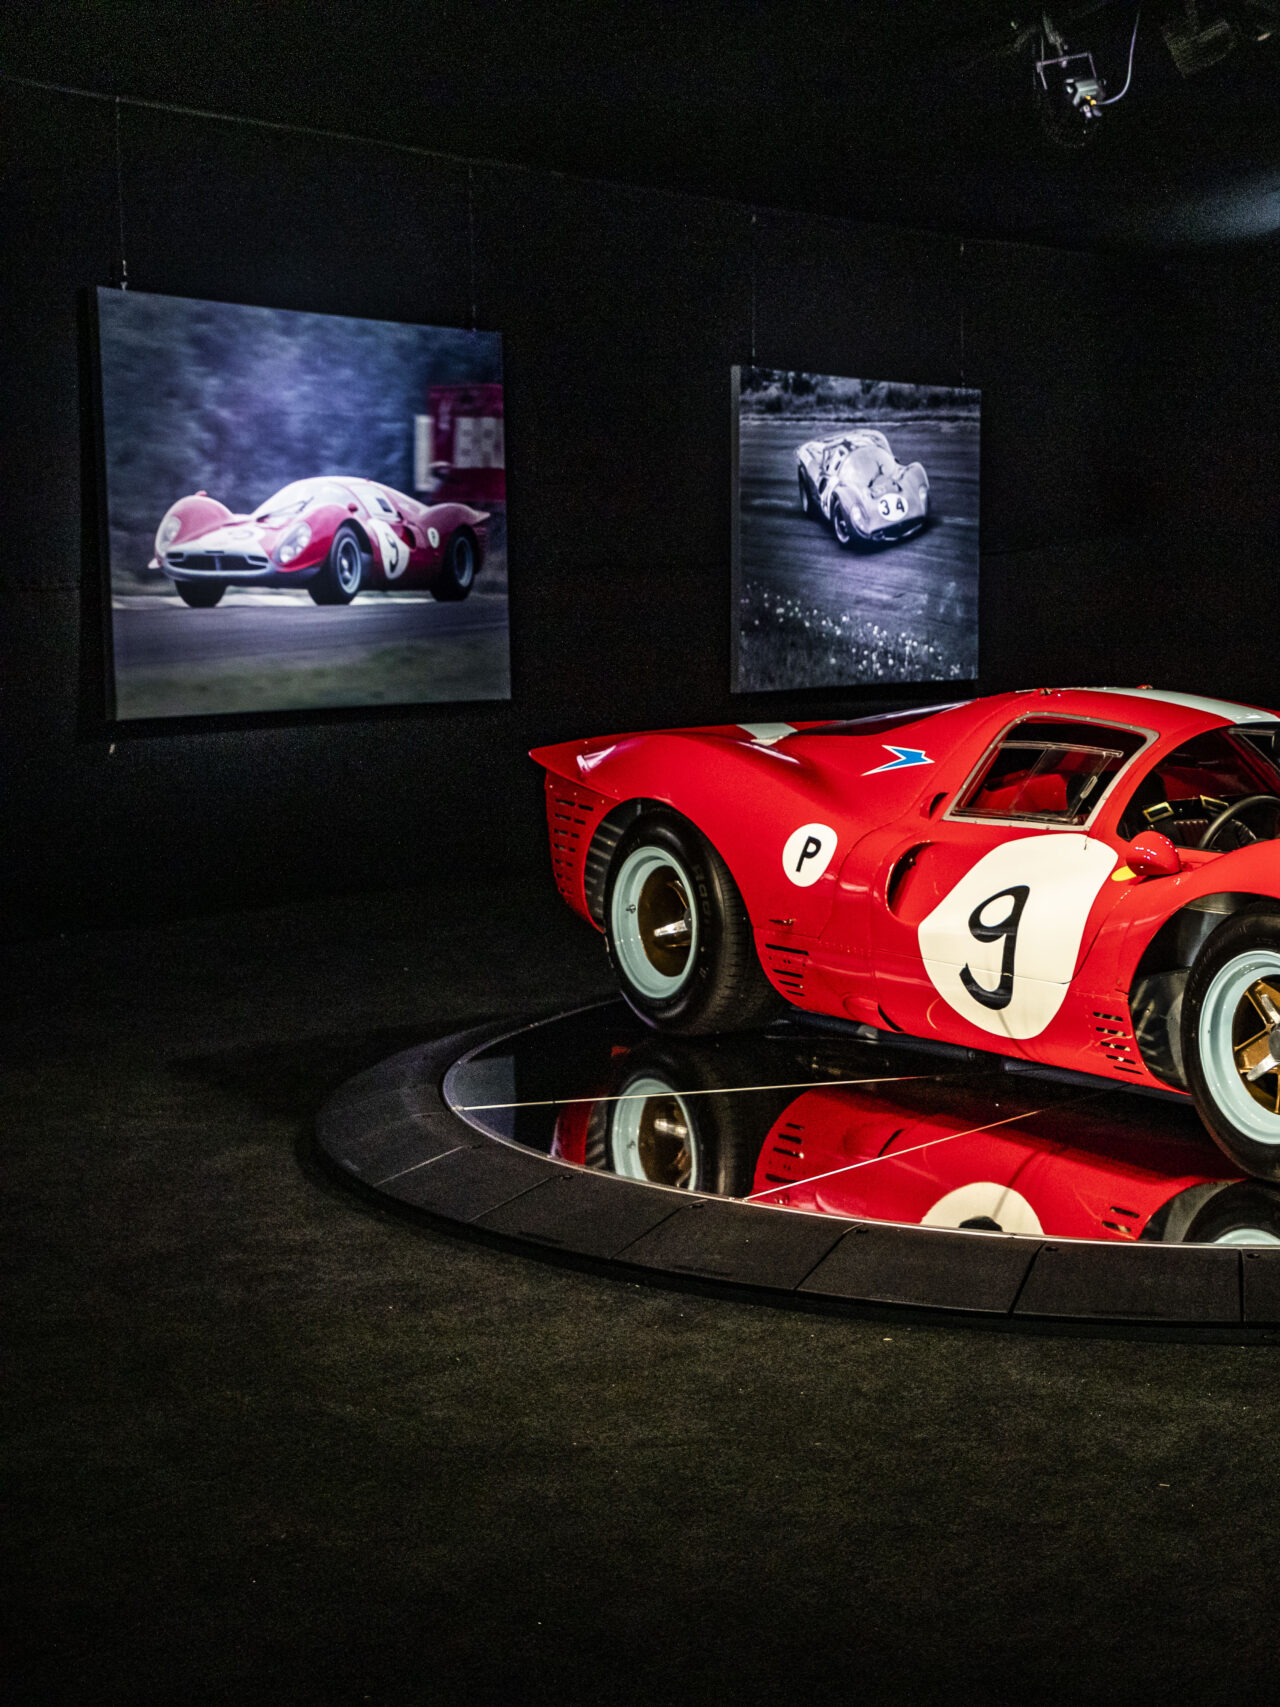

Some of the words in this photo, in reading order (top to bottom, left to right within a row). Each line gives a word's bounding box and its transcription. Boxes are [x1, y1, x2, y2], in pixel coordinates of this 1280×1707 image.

[880, 498, 905, 516] 34
[797, 836, 822, 873] P
[959, 885, 1031, 1011] 9
